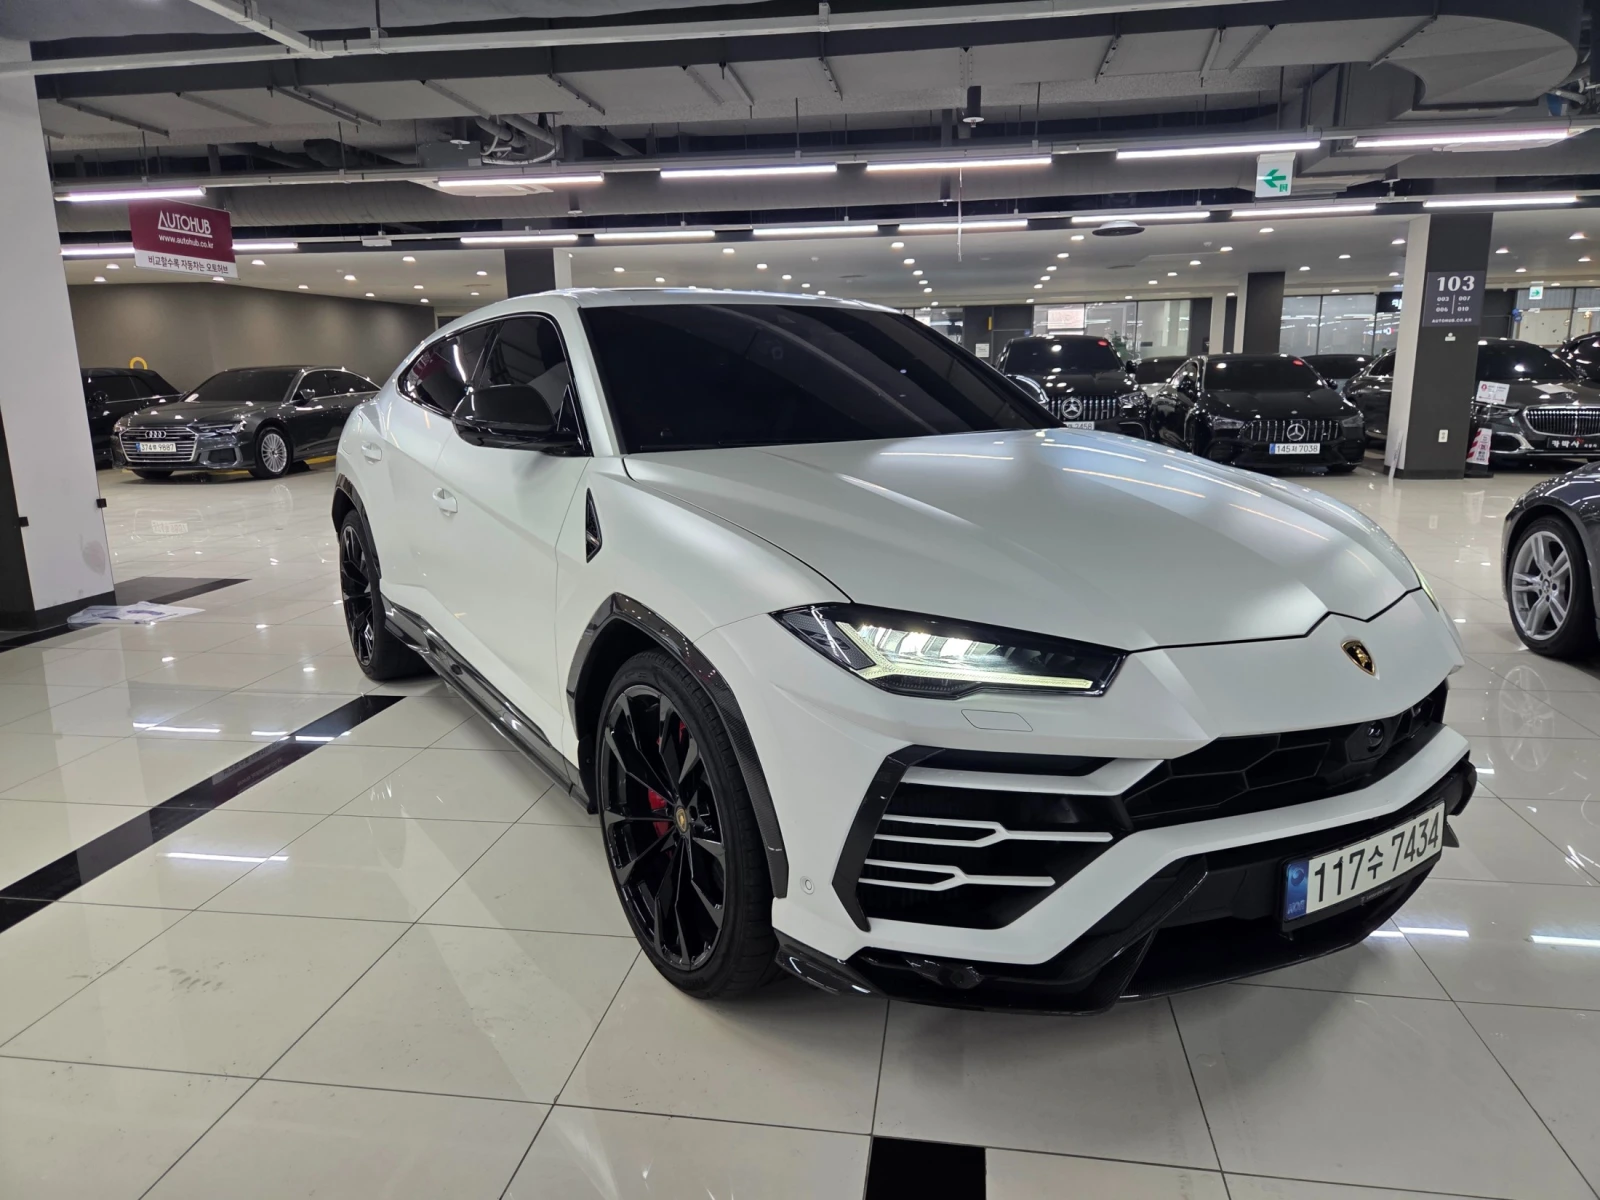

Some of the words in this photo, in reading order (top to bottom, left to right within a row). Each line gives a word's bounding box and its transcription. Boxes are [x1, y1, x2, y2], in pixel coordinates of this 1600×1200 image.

[158, 210, 212, 236] AUTOHUB
[158, 234, 214, 249] www.autohub.co.kr
[148, 255, 181, 269] 비교할수록
[181, 259, 206, 272] 자동차는
[206, 263, 229, 275] 오토허브
[1437, 275, 1475, 292] 103
[1314, 845, 1384, 903] 117수
[1391, 811, 1440, 873] 7434
